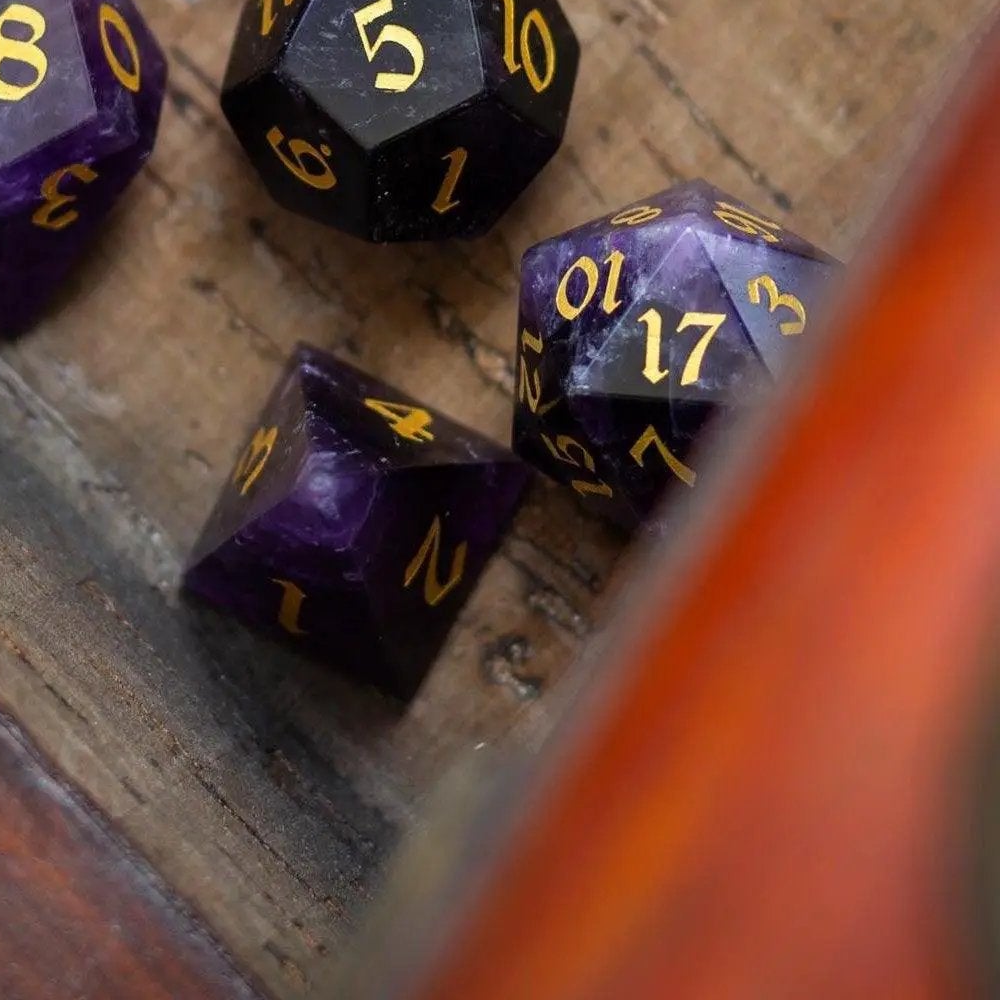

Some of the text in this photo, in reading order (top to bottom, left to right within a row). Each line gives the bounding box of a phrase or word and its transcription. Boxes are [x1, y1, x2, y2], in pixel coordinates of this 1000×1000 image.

[99, 3, 140, 93] 0
[32, 163, 98, 231] 3
[432, 147, 467, 214] 1
[747, 274, 806, 336] 3
[637, 308, 727, 387] 17
[363, 398, 435, 443] 4
[628, 424, 698, 487] 7
[404, 514, 468, 607] 2
[271, 577, 309, 636] 1
